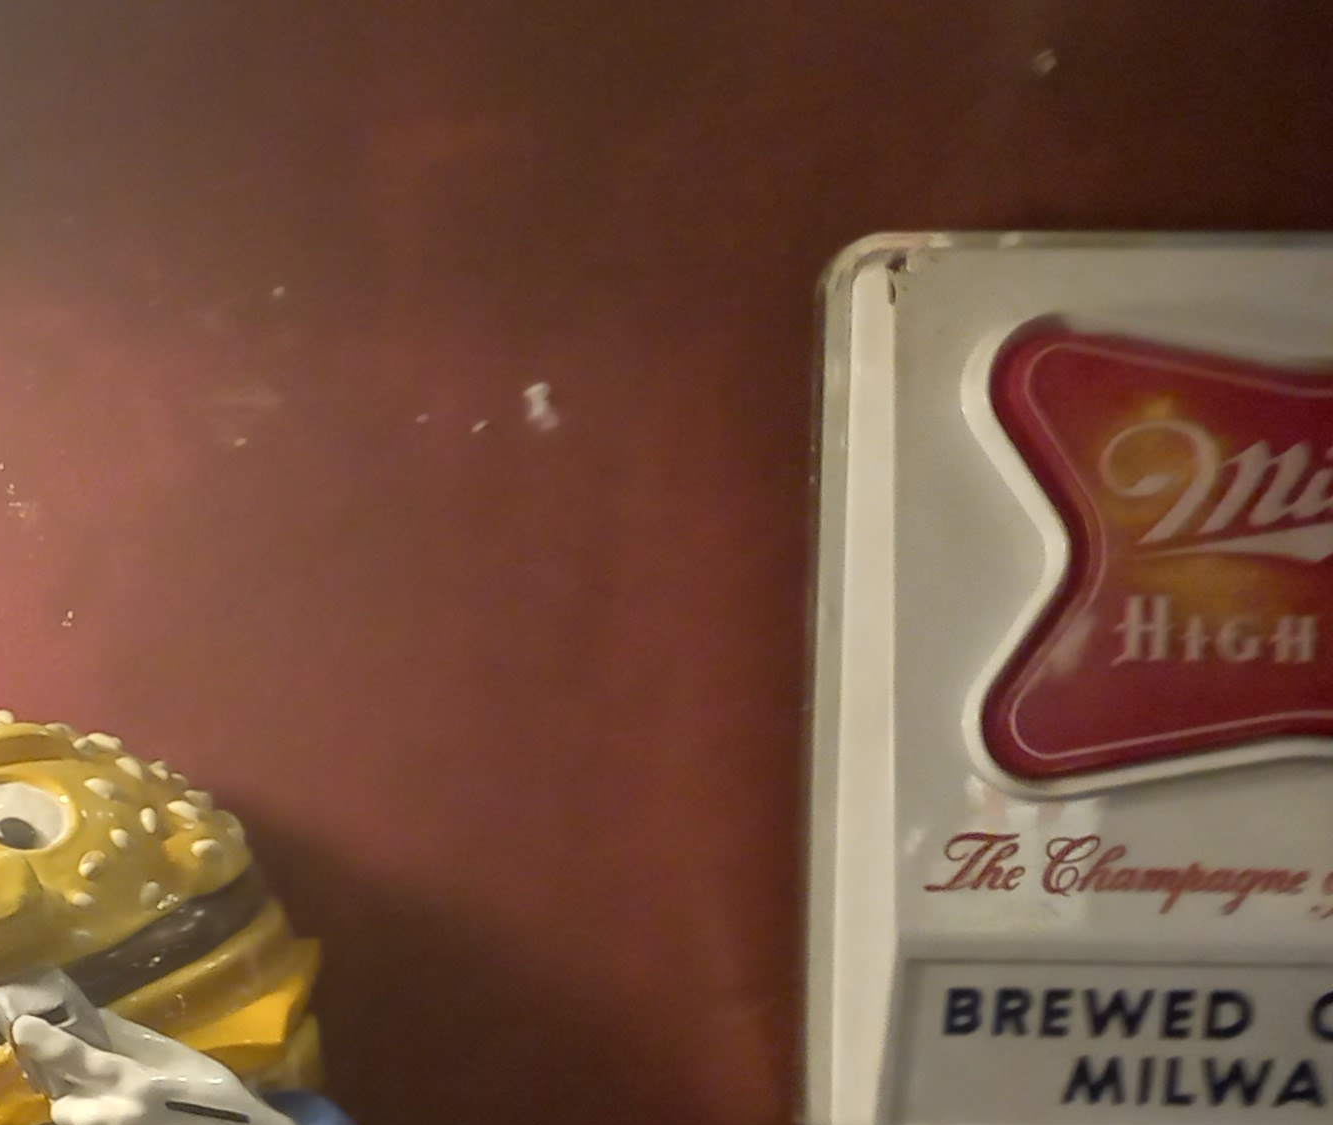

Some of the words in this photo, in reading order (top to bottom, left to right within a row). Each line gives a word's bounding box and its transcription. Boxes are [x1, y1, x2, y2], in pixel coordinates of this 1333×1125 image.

[924, 831, 1027, 893] The
[1041, 833, 1311, 917] Champagne
[942, 986, 1255, 1040] BREWED
[1060, 1054, 1326, 1108] MILWA
